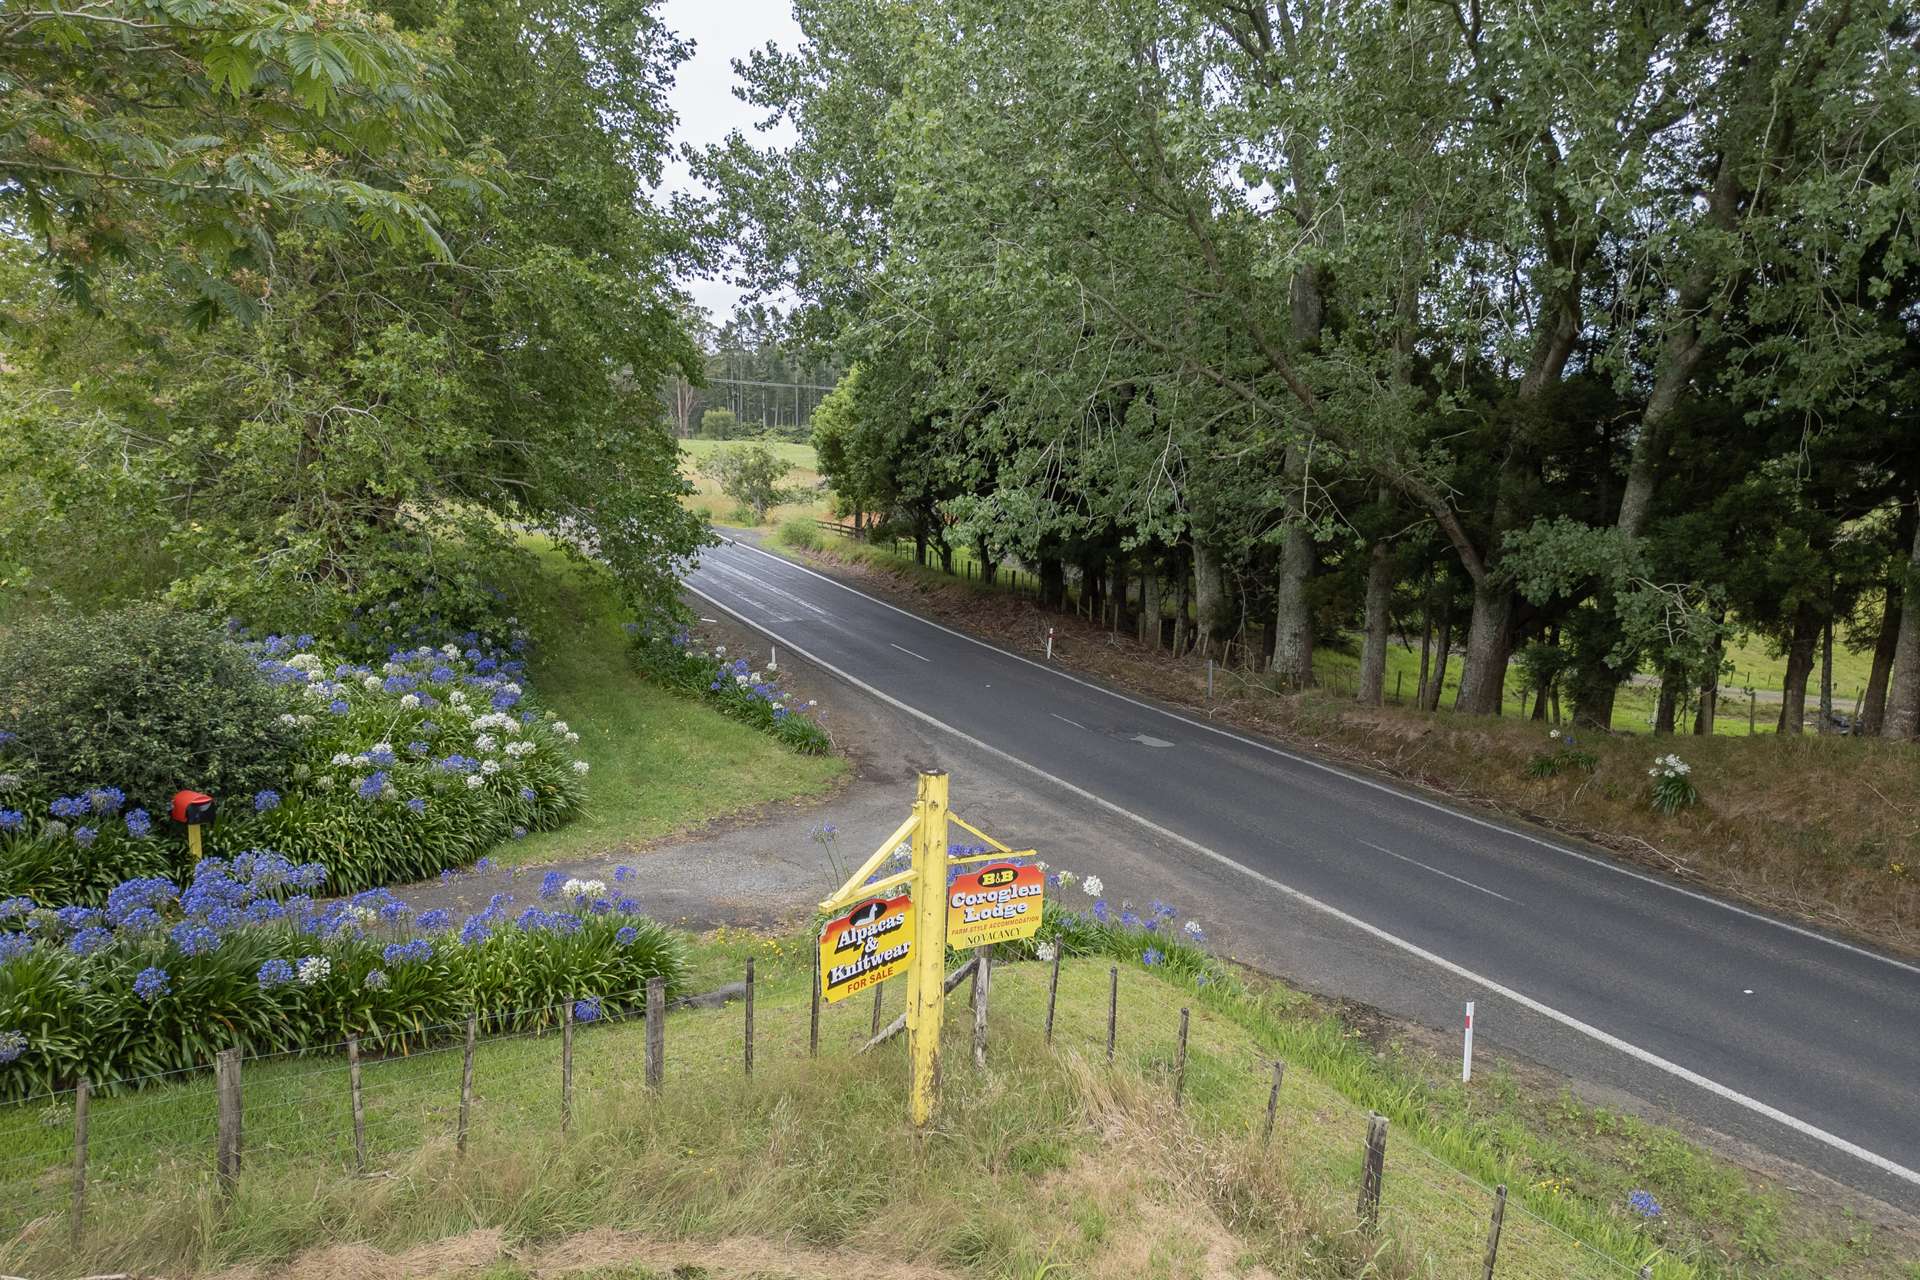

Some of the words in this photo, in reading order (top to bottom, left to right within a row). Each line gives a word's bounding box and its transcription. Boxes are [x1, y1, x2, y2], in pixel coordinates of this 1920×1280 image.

[982, 870, 1014, 886] B&B
[951, 884, 1041, 908] Coroglen
[964, 902, 1028, 923] Lodge
[836, 912, 905, 950] Alpacas
[980, 927, 1021, 941] VACANCY
[864, 936, 879, 953] &
[830, 941, 911, 986] Knitwear
[847, 977, 868, 994] FOR
[869, 966, 894, 984] SALE
